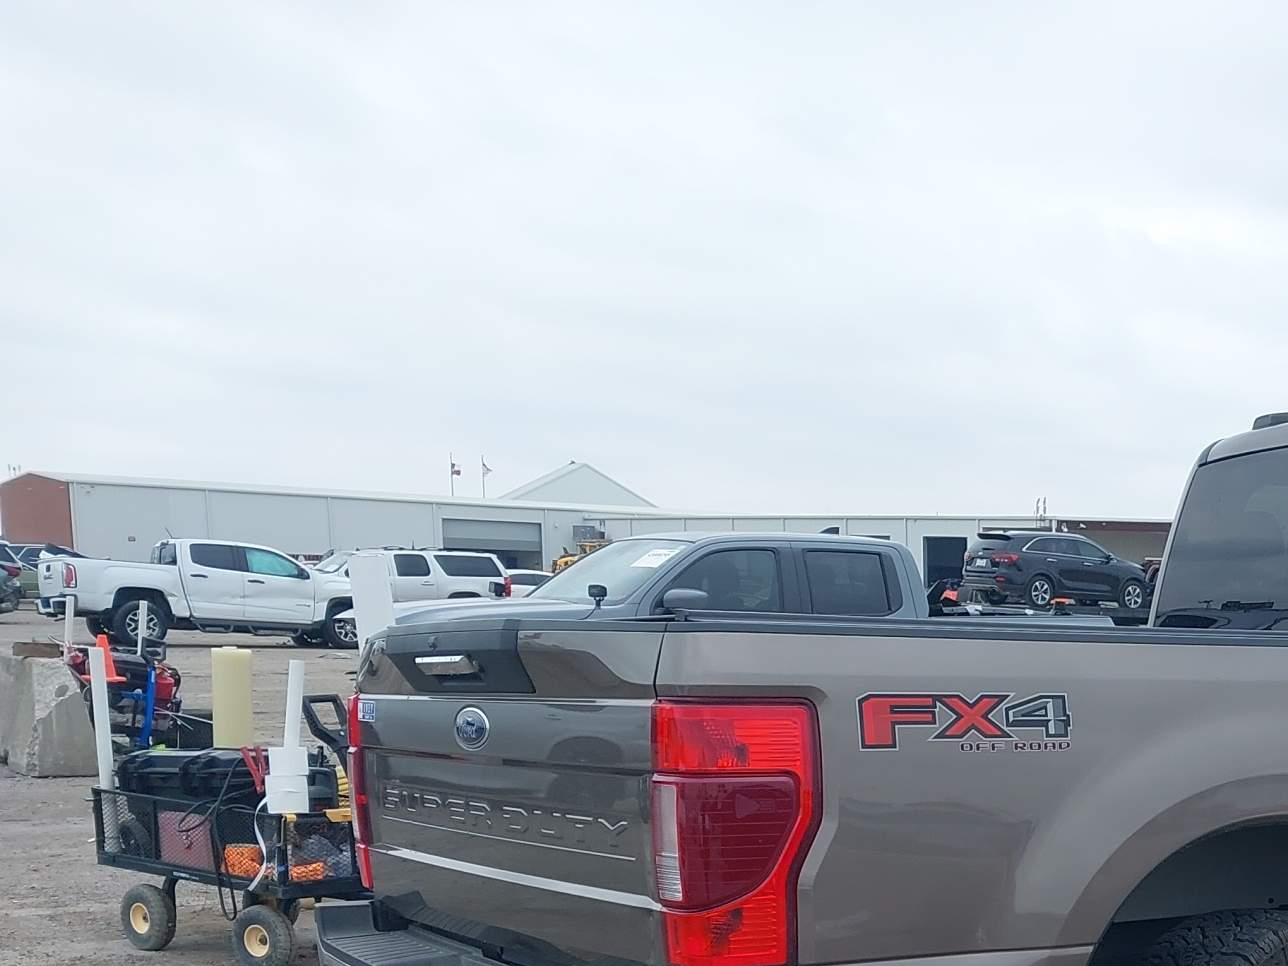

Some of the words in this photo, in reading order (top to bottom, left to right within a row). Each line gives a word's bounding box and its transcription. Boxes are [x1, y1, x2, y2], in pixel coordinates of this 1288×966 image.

[856, 692, 1072, 751] FX4
[959, 741, 1006, 753] OFF
[1013, 740, 1072, 753] ROAD
[384, 789, 493, 826] SUPER
[502, 805, 629, 847] DUTY
